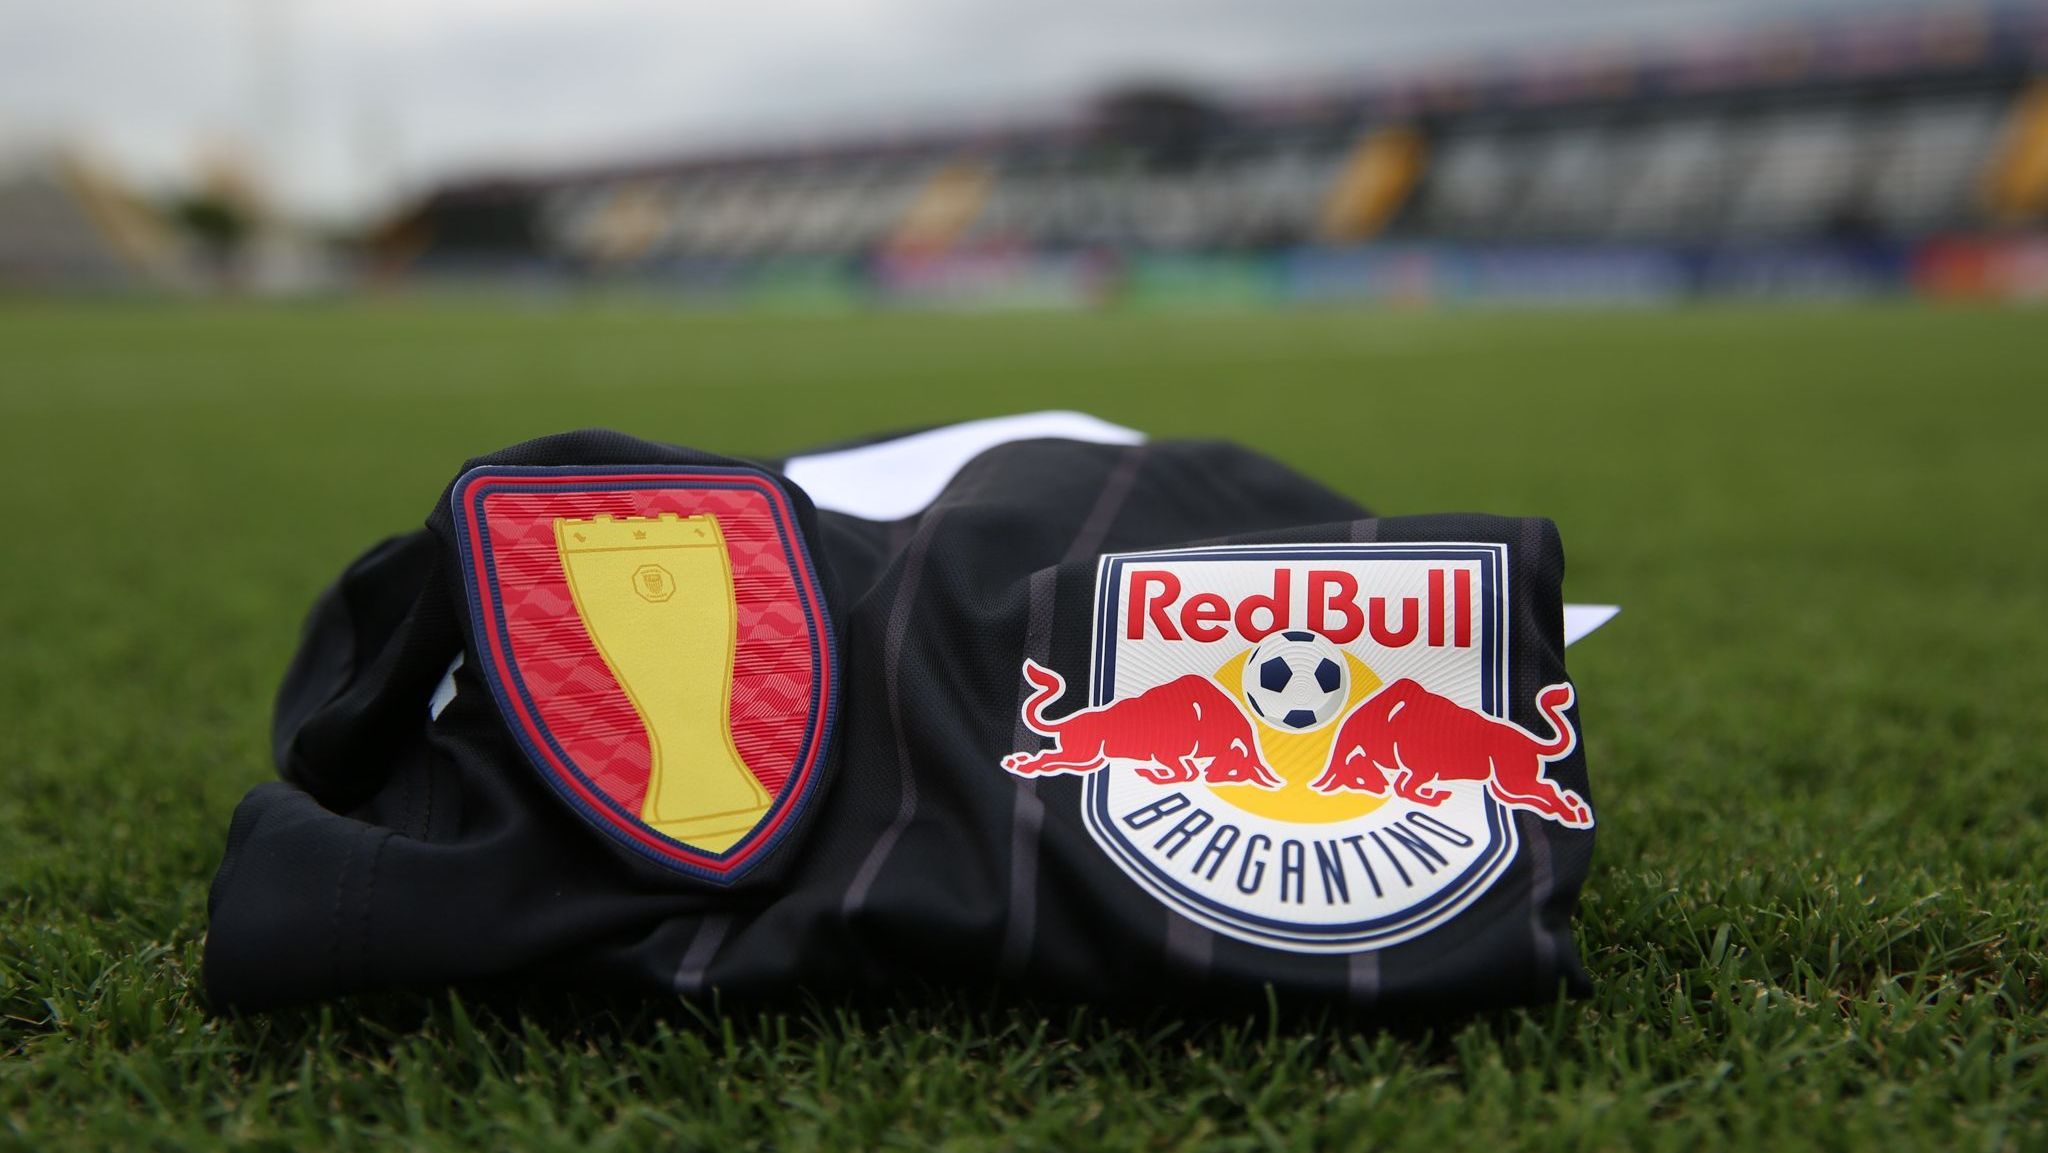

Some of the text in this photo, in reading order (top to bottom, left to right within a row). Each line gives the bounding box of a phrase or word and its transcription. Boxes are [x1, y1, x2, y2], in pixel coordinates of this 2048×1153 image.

[1127, 568, 1471, 648] Red Bull
[1122, 792, 1474, 905] BRAGANTINO
